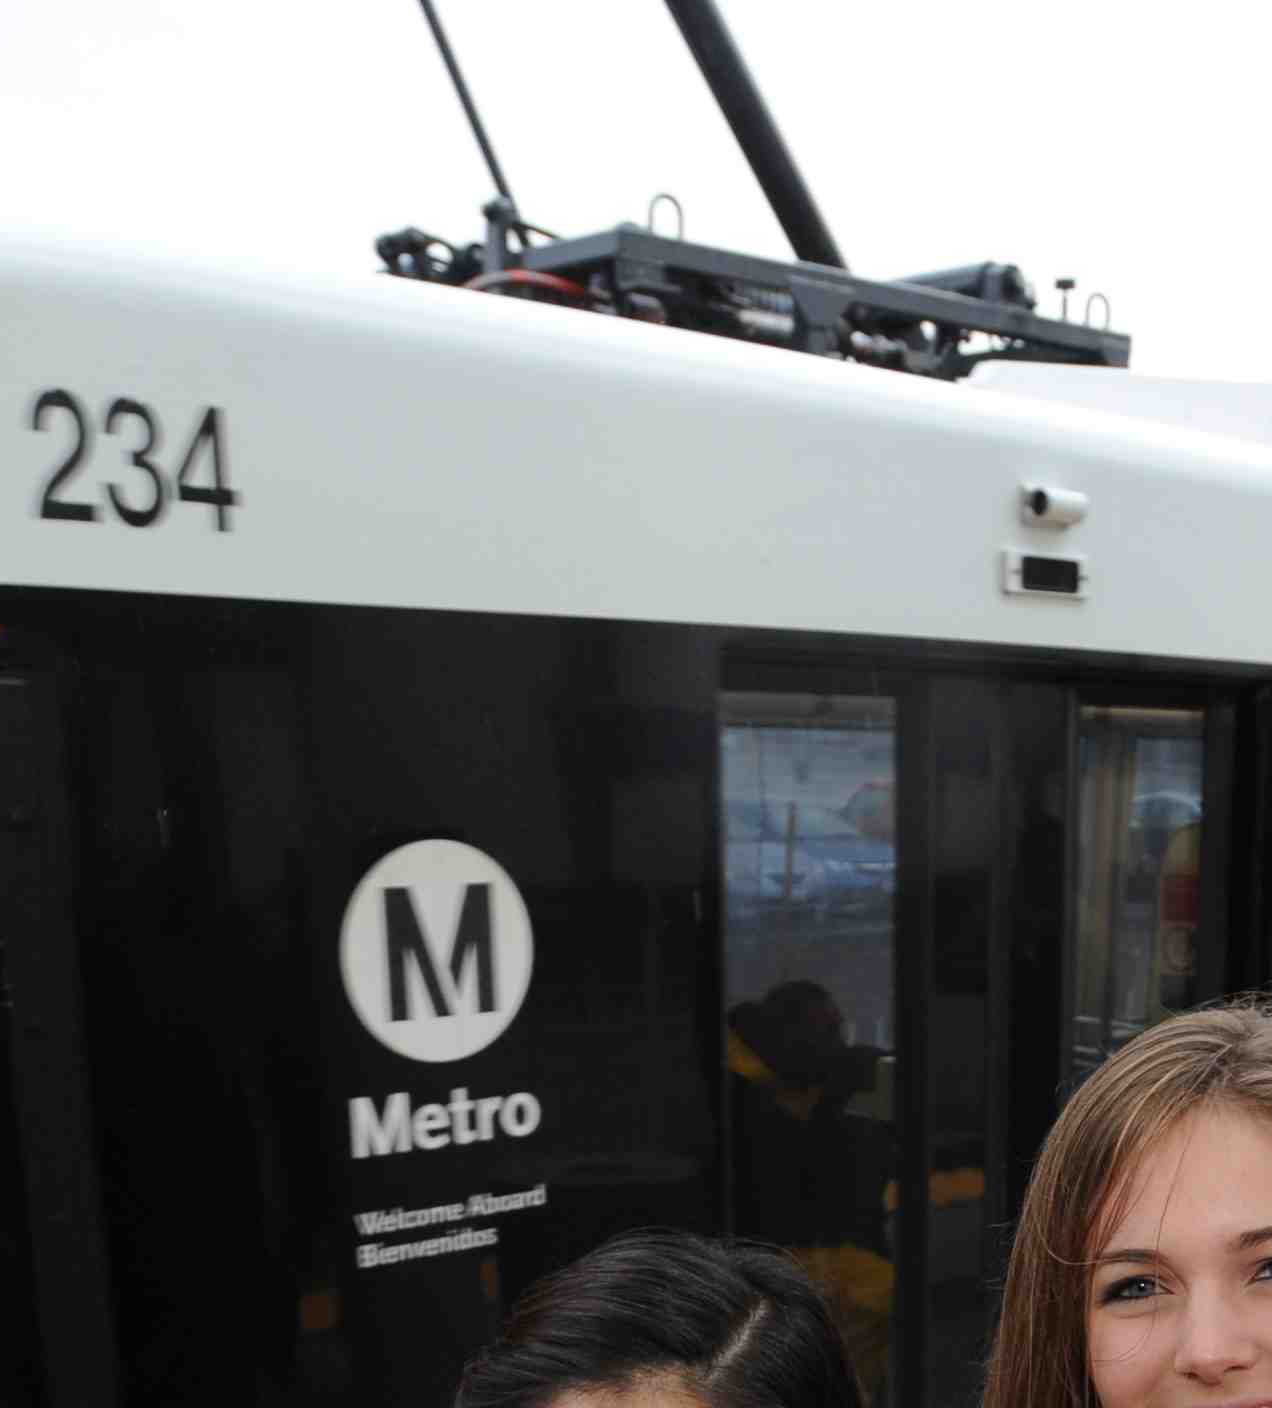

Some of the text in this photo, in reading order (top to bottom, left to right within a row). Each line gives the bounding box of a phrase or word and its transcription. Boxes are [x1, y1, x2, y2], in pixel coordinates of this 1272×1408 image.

[32, 388, 239, 531] 234
[382, 882, 497, 1022] M
[348, 1088, 541, 1159] Metro
[353, 1183, 547, 1235] Welcome Aboard
[356, 1227, 499, 1268] Bienvenidos
